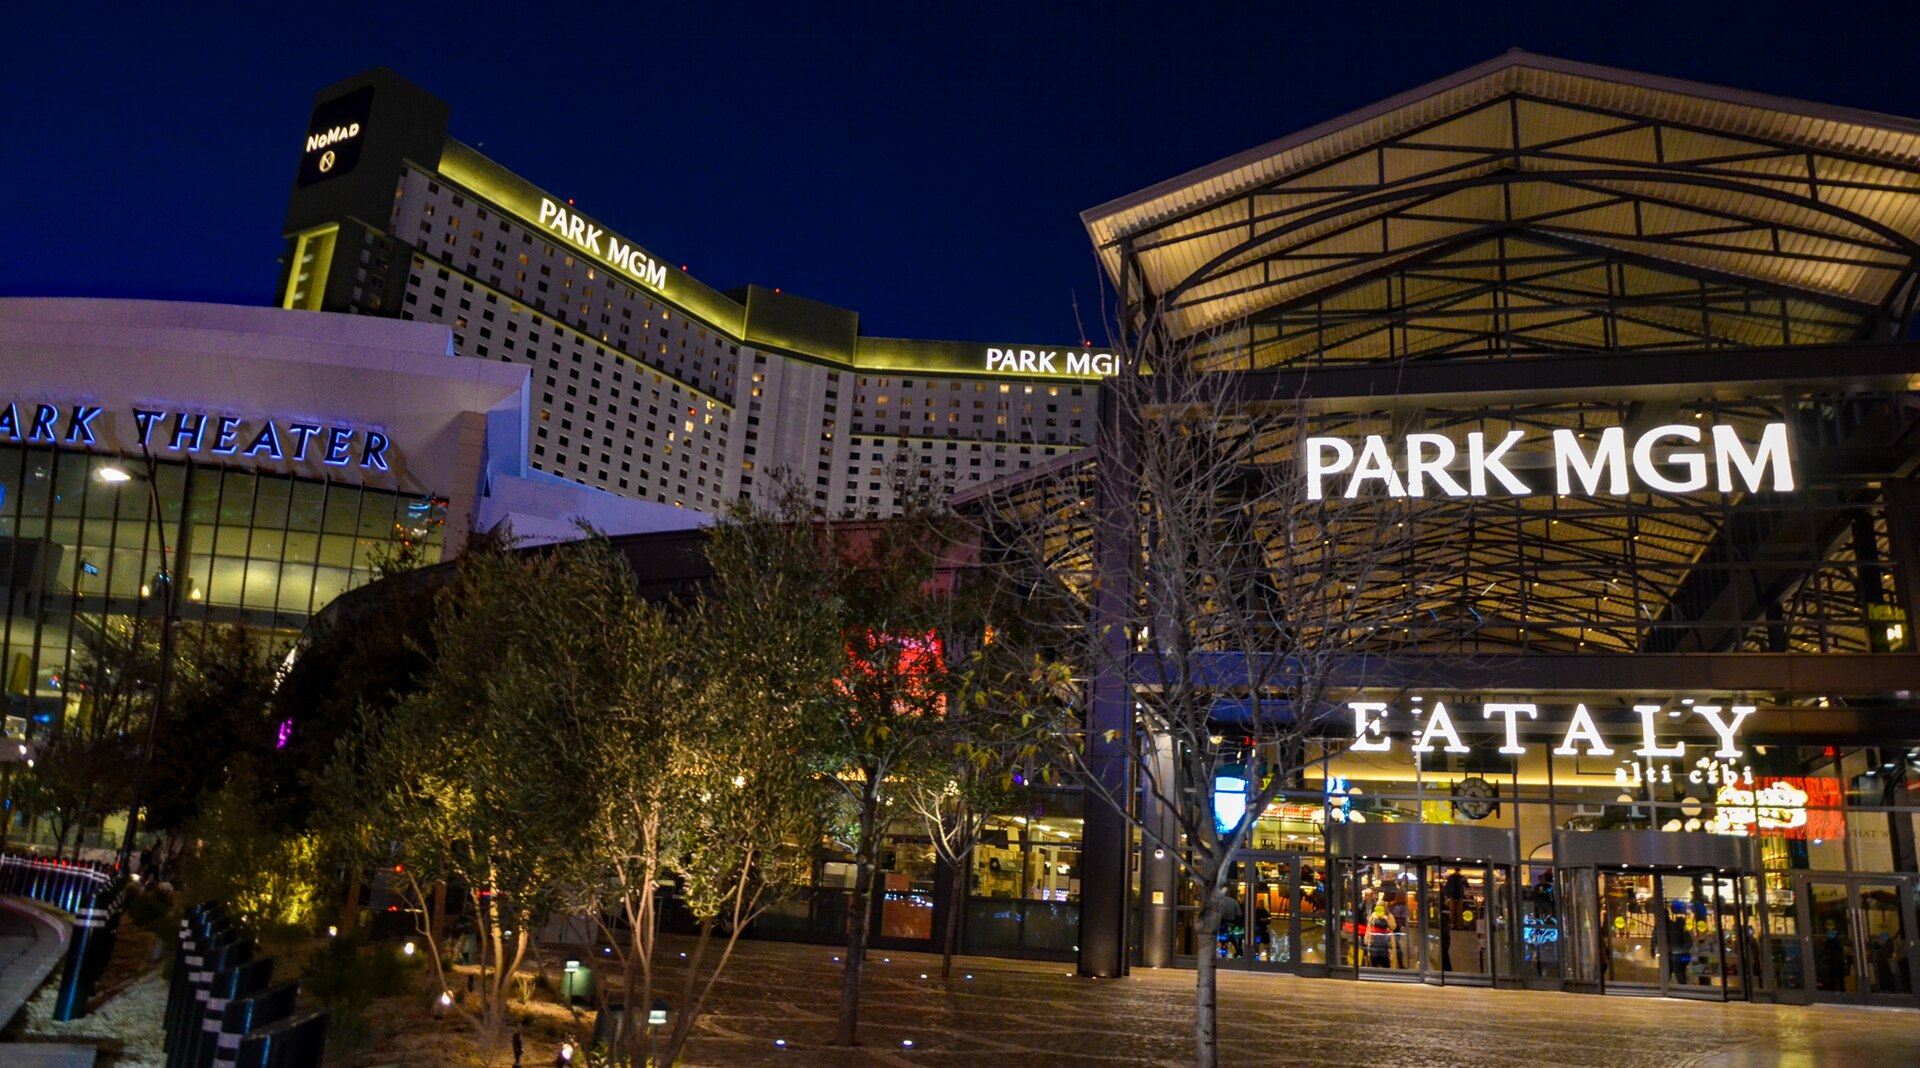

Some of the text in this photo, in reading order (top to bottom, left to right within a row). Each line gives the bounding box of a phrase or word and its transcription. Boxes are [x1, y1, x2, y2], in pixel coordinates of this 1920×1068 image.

[539, 197, 667, 290] PARK MGM
[985, 348, 1058, 374] PARK
[135, 408, 390, 471] THEATER
[1306, 423, 1795, 500] PARK MGM
[1347, 701, 1757, 758] EATALY
[1614, 761, 1754, 787] alti cibi
